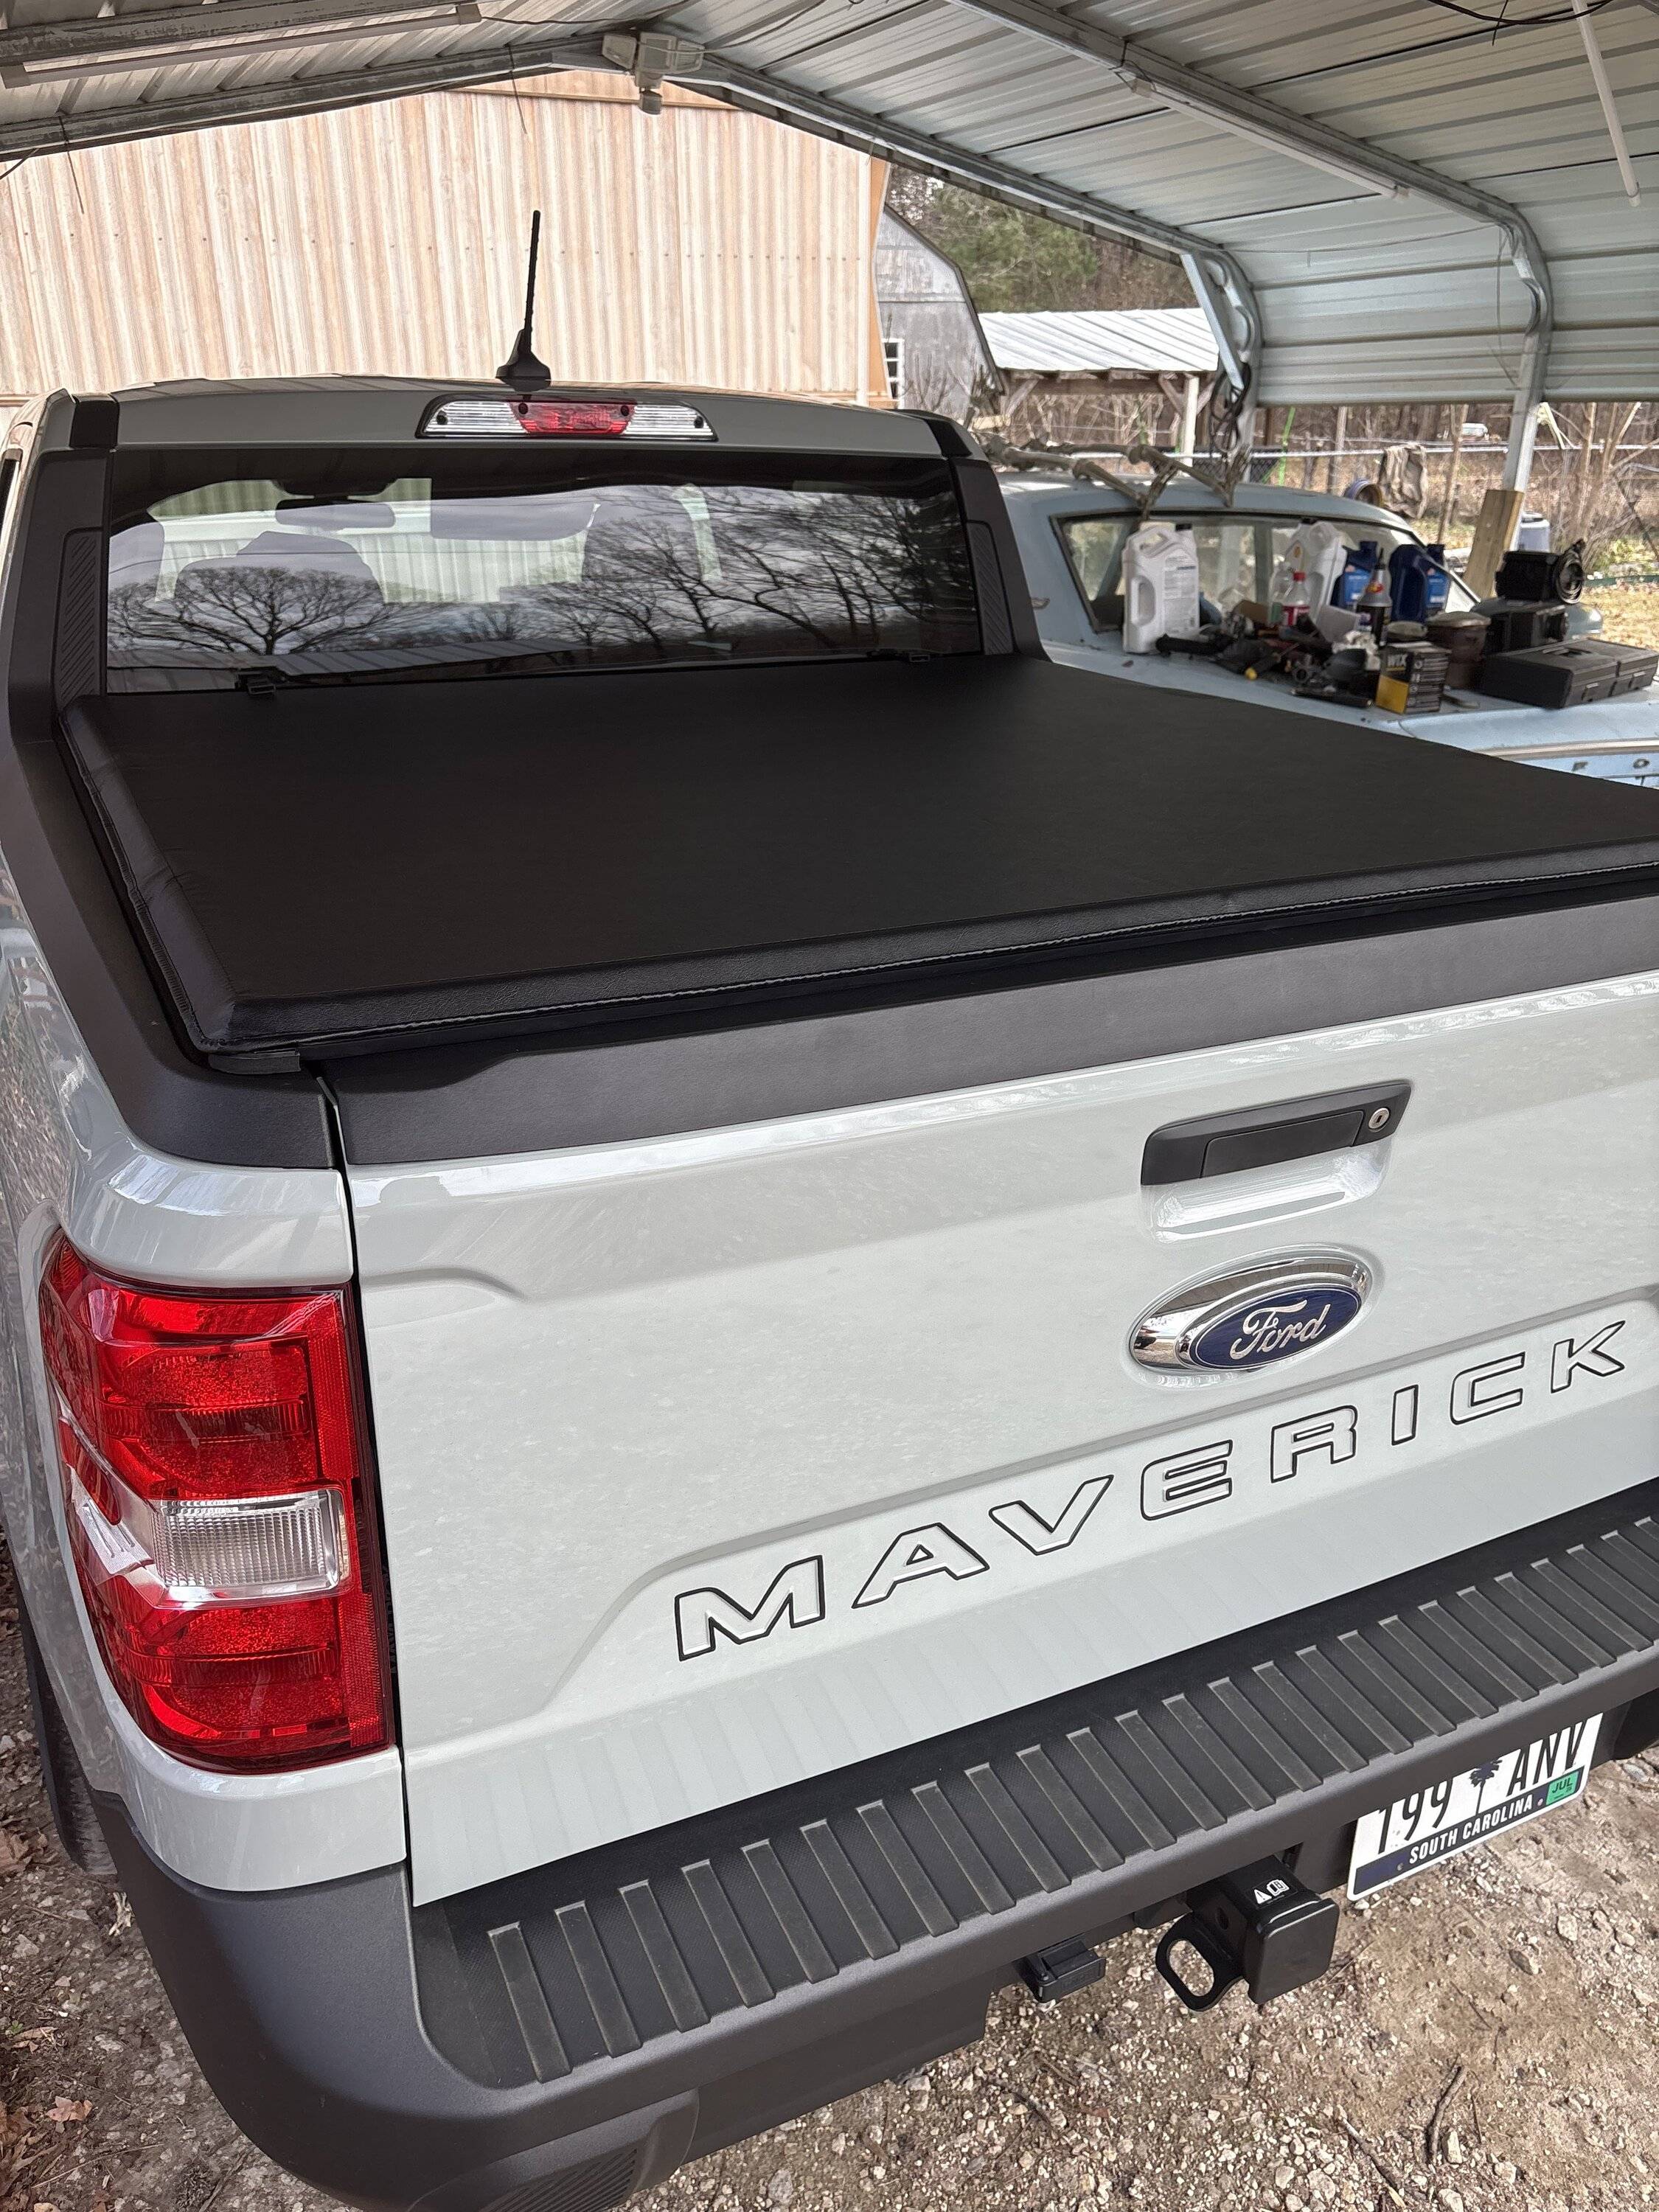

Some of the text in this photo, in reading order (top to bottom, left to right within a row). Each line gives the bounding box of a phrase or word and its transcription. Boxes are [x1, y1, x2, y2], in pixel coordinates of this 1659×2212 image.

[1229, 1299, 1331, 1360] Ford
[675, 1320, 1626, 1660] MAVERICK
[1506, 1719, 1587, 1798] ANV
[1551, 1777, 1573, 1793] JUL
[1409, 1794, 1533, 1864] SOUTH CAROLINA
